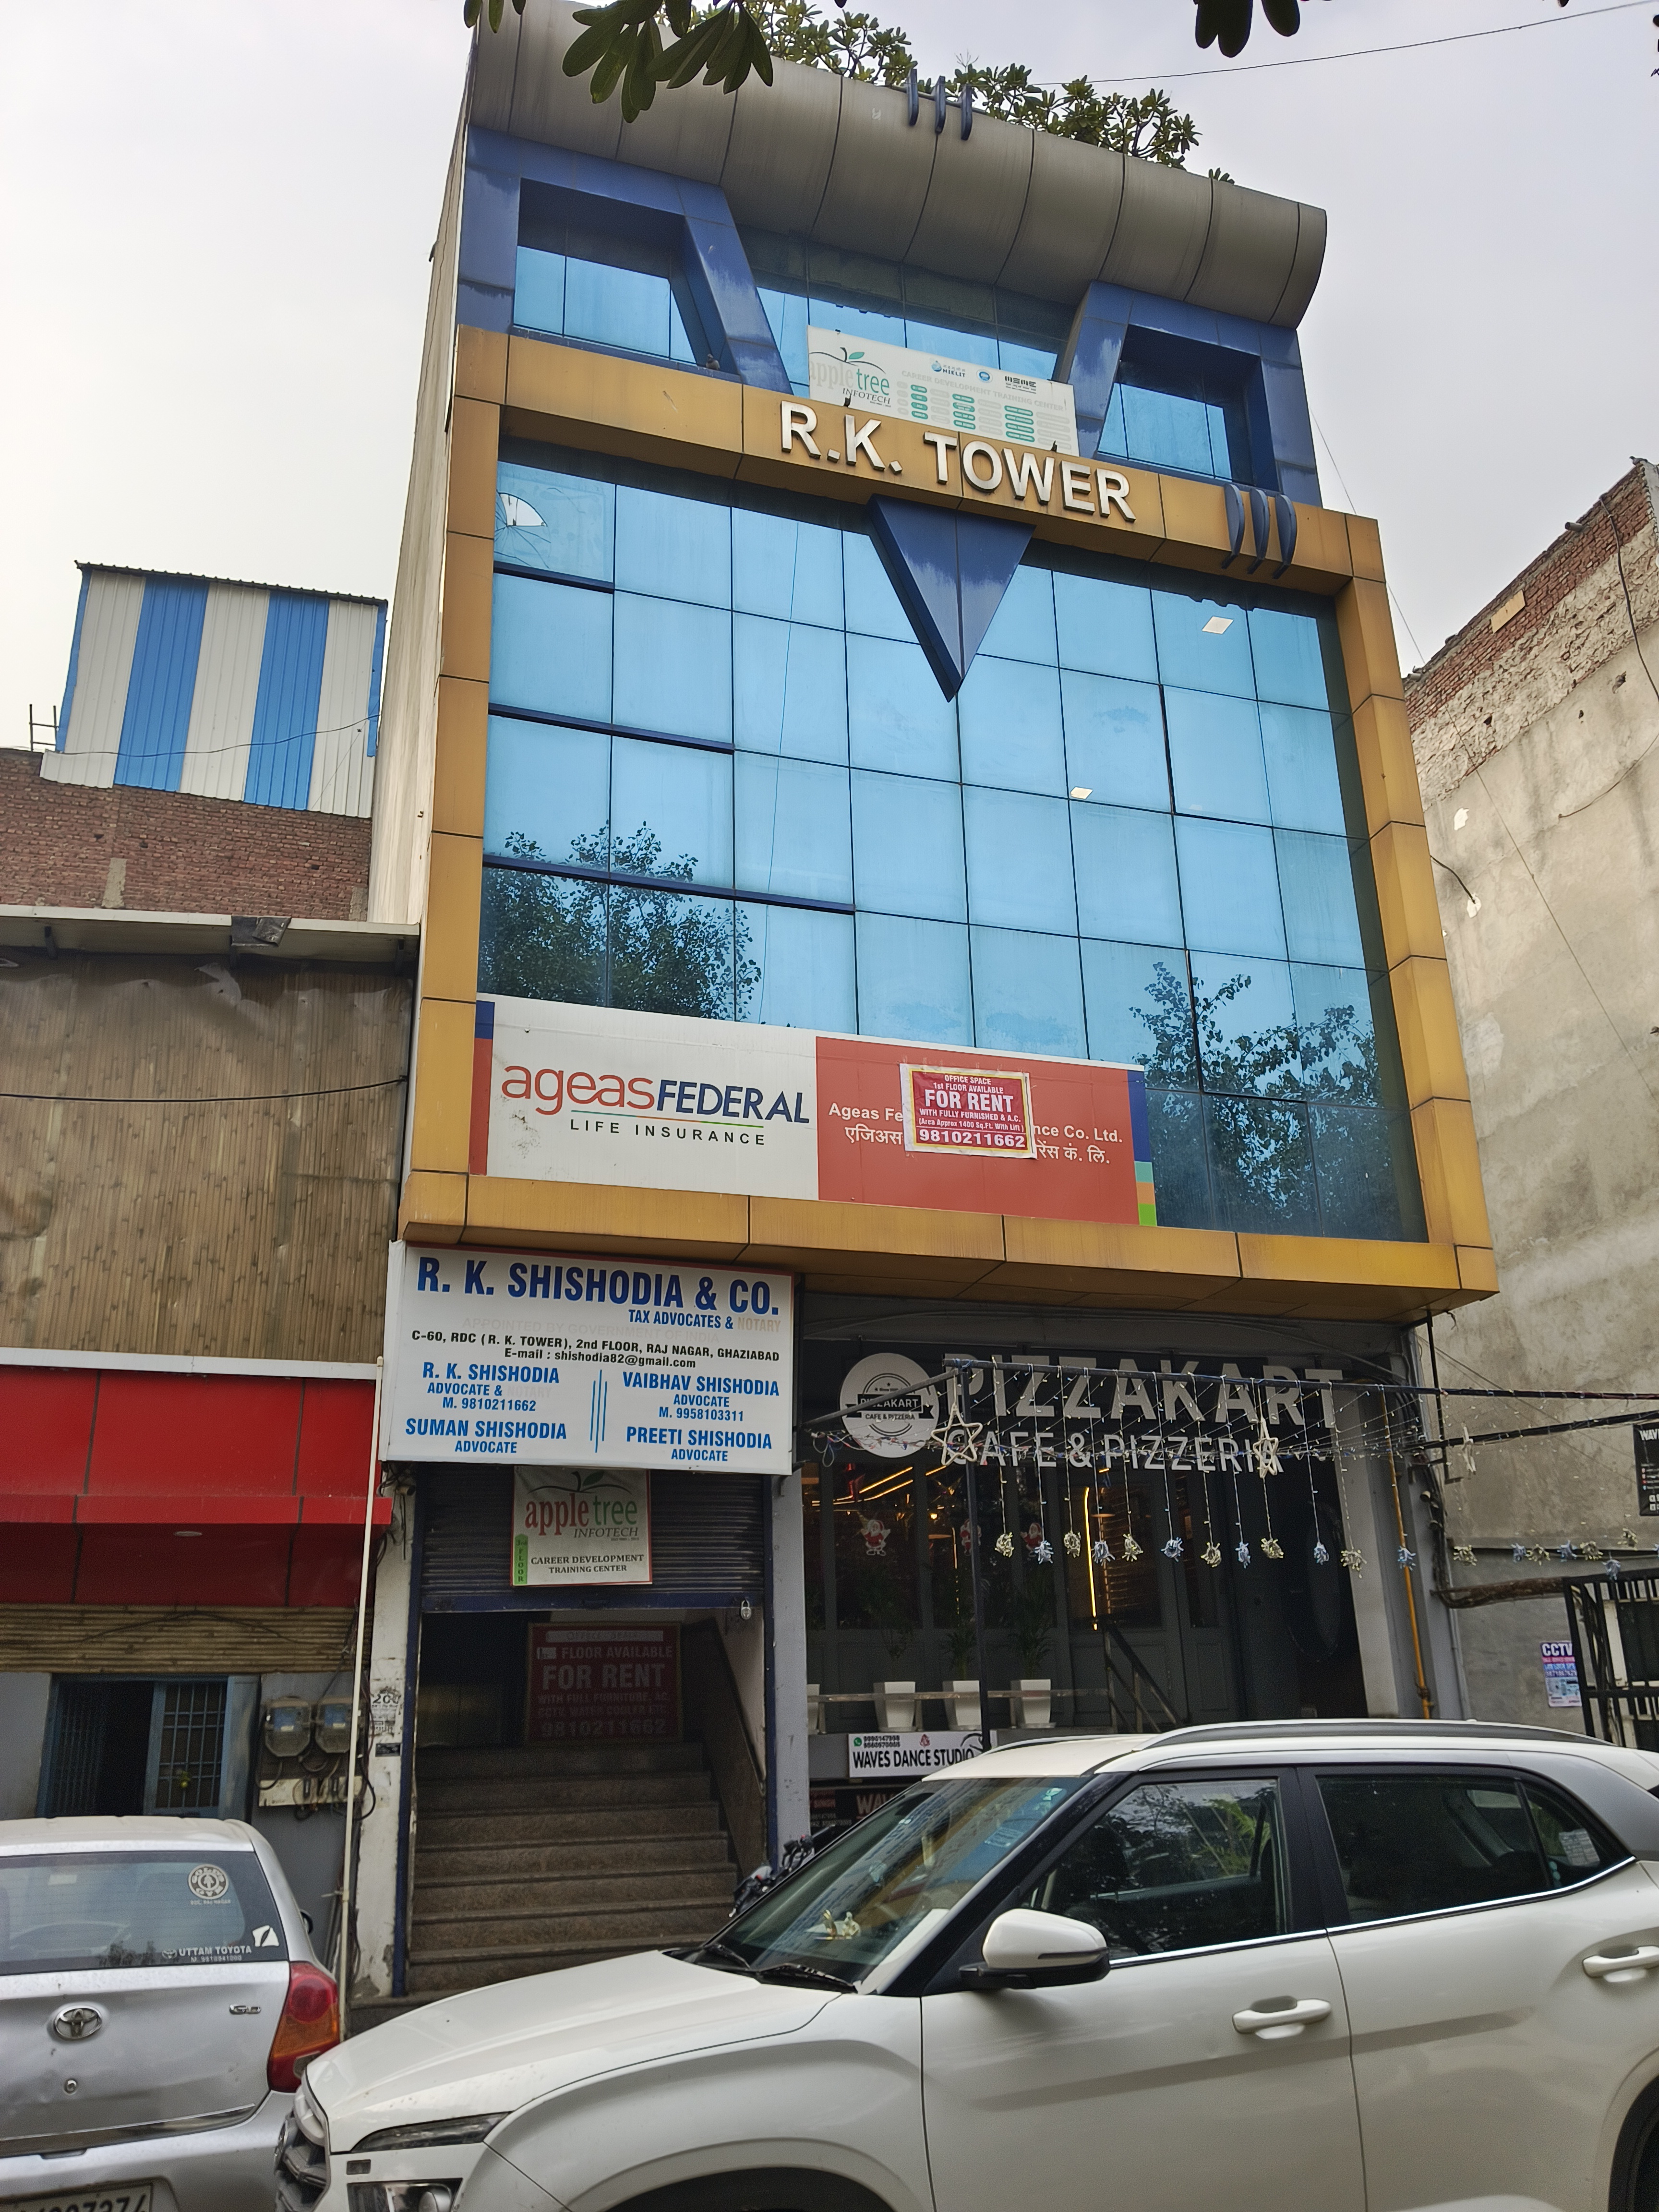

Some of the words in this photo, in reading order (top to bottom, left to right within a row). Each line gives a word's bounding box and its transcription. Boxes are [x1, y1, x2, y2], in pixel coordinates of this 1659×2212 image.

[856, 368, 890, 396] tree
[902, 370, 932, 382] CAREER
[934, 378, 991, 395] DEVELOPMENT
[993, 391, 1032, 405] TRAINING
[1034, 400, 1064, 411] CENTER
[843, 387, 890, 404] INFOTECH
[923, 431, 1136, 522] TOWER
[944, 1075, 968, 1084] OFFICE
[970, 1077, 991, 1085] SPACE
[946, 1083, 967, 1092] FLOOR
[968, 1085, 1004, 1094] AVAILABLE
[657, 1079, 810, 1124] FEDERAL
[925, 1089, 962, 1109] FOR
[967, 1093, 1013, 1113] RENT
[829, 1103, 879, 1120] Ageas
[885, 1108, 903, 1122] Fe
[919, 1108, 937, 1117] WITH
[939, 1110, 959, 1118] FULLY
[961, 1111, 998, 1121] FURNISHED
[919, 1118, 935, 1126] (Area
[937, 1119, 957, 1127] Approx
[570, 1118, 620, 1134] LIFE
[635, 1124, 766, 1145] INSURANCE
[919, 1129, 1025, 1148] 9810211662
[1034, 1125, 1059, 1136] nce
[1064, 1125, 1089, 1140] Co.
[1094, 1128, 1122, 1142] Ltd.
[1035, 1139, 1059, 1159] रेंस
[1063, 1142, 1082, 1161] कं.
[1087, 1145, 1110, 1164] लि.
[417, 1257, 450, 1292] R.
[464, 1260, 494, 1295] K.
[507, 1262, 684, 1308] SHISHODIA
[695, 1276, 717, 1311] &
[729, 1279, 779, 1315] CO.
[628, 1309, 650, 1323] TAX
[653, 1311, 721, 1329] ADVOCATES
[725, 1316, 733, 1329] &
[738, 1317, 781, 1333] NOTARY
[412, 1330, 446, 1344] C-60,
[451, 1332, 476, 1343] RDC
[505, 1335, 516, 1346] K.
[576, 1339, 597, 1350] 2nd
[601, 1340, 642, 1354] FLOOR,
[646, 1344, 668, 1354] RAJ
[672, 1345, 713, 1358] NAGAR,
[717, 1348, 780, 1361] GHAZIABAD
[505, 1348, 543, 1359] E-mail
[554, 1351, 696, 1369] shishodia82@gmail.com
[422, 1362, 440, 1379] R.
[446, 1363, 461, 1380] K.
[468, 1364, 559, 1383] SHISHODIA
[427, 1382, 490, 1396] ADVOCATE
[494, 1385, 503, 1396] &
[623, 1371, 691, 1391] VAIBHAV
[696, 1376, 780, 1396] SHISHODIA
[944, 1353, 1343, 1428] PIZZAKART
[443, 1397, 457, 1409] M.
[461, 1398, 536, 1411] 9810211662
[673, 1394, 730, 1407] ADVOCATE
[659, 1407, 672, 1418] M.
[676, 1407, 743, 1422] 9958103311
[406, 1418, 469, 1436] SUMAN
[475, 1420, 566, 1440] SHISHODIA
[626, 1426, 682, 1445] PREETI
[688, 1430, 772, 1449] SHISHODIA
[1640, 1429, 1659, 1440] WAV
[455, 1440, 517, 1454] ADVOCATE
[671, 1449, 728, 1462] ADVOCATE
[948, 1430, 1057, 1467] CAFE
[1070, 1432, 1093, 1468] &
[1103, 1434, 1284, 1473] PIZZERIA
[525, 1492, 589, 1536] apple
[593, 1495, 637, 1526] tree
[574, 1527, 638, 1539] INFOTECH
[531, 1557, 570, 1565] CAREER
[572, 1554, 644, 1563] DEVELOPMENT
[562, 1647, 602, 1659] FLOOR
[607, 1646, 673, 1659] AVAILABLE
[1542, 1643, 1573, 1656] CCTV
[542, 1664, 592, 1690] FOR
[601, 1663, 665, 1688] RENT
[853, 1750, 890, 1769] WAVES
[894, 1749, 931, 1767] DANCE
[934, 1748, 974, 1766] STUDIO
[179, 1947, 213, 1957] UTTAM
[215, 1945, 252, 1955] TOYOTA
